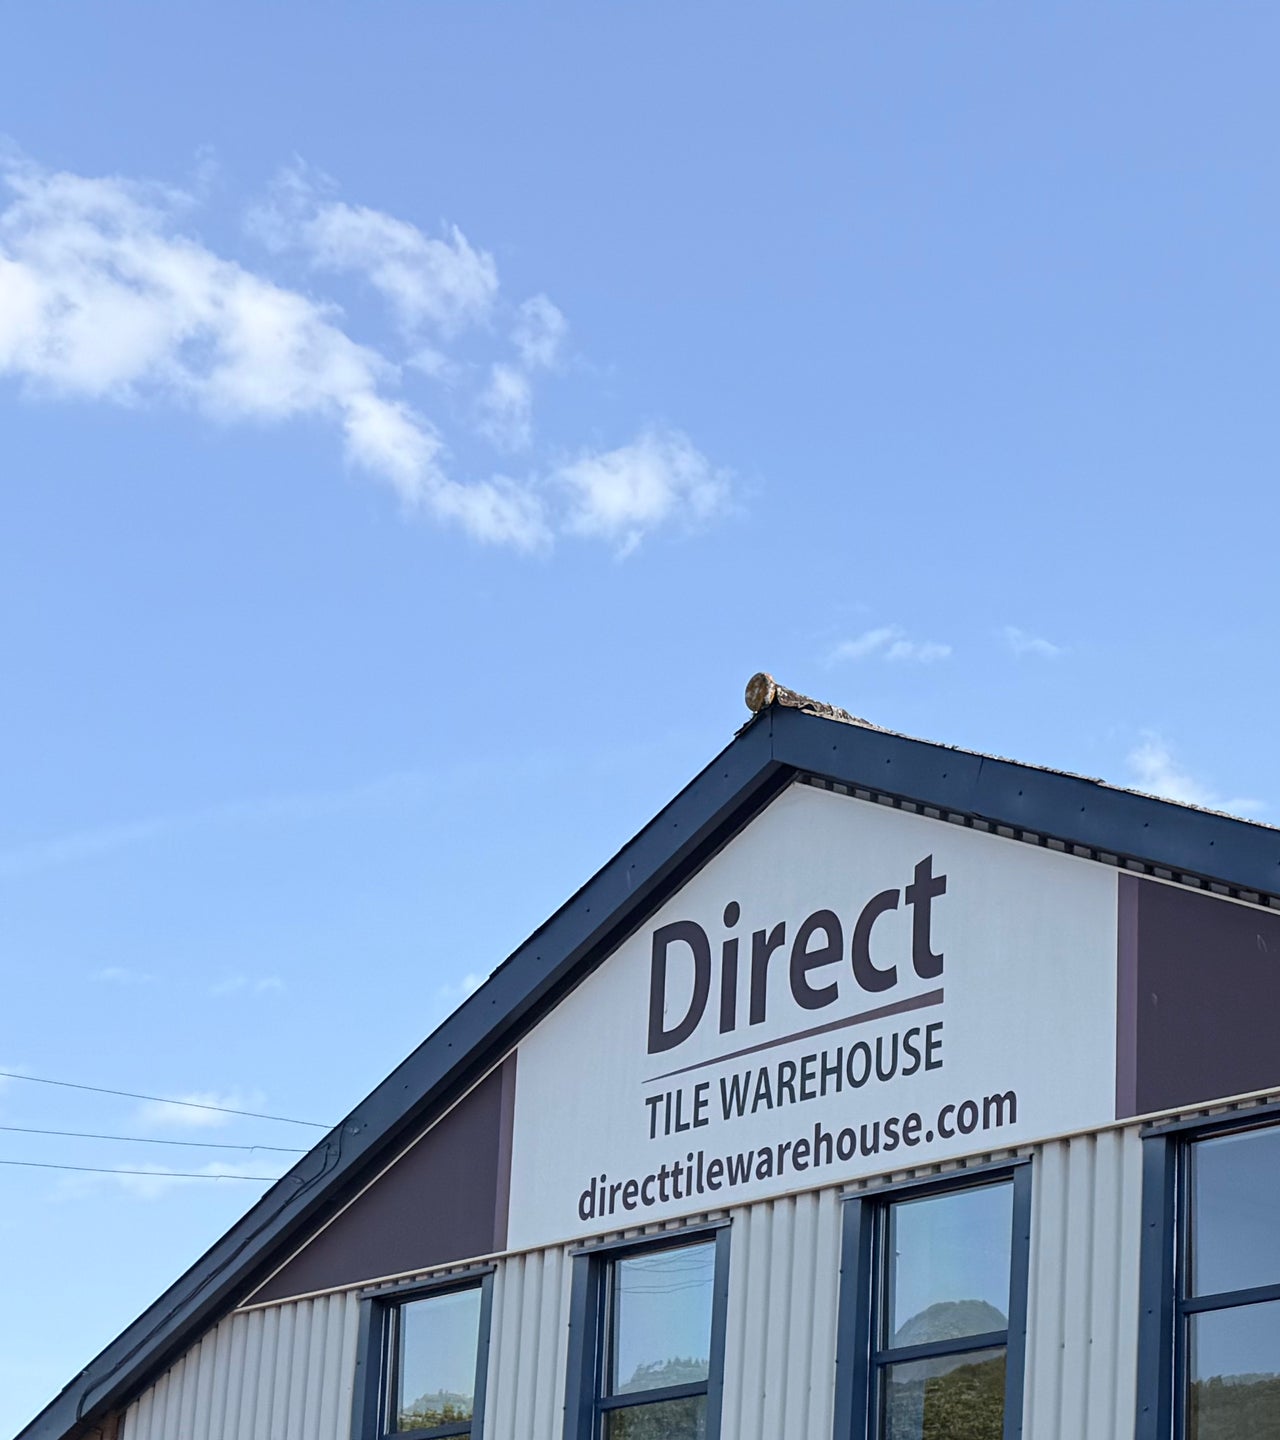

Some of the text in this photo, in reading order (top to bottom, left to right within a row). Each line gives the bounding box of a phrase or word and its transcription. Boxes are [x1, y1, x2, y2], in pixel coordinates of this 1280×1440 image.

[647, 853, 947, 1055] Direct
[645, 1022, 944, 1139] TILE WAREHOUSE
[578, 1089, 1018, 1221] directtilewarehouse.com
